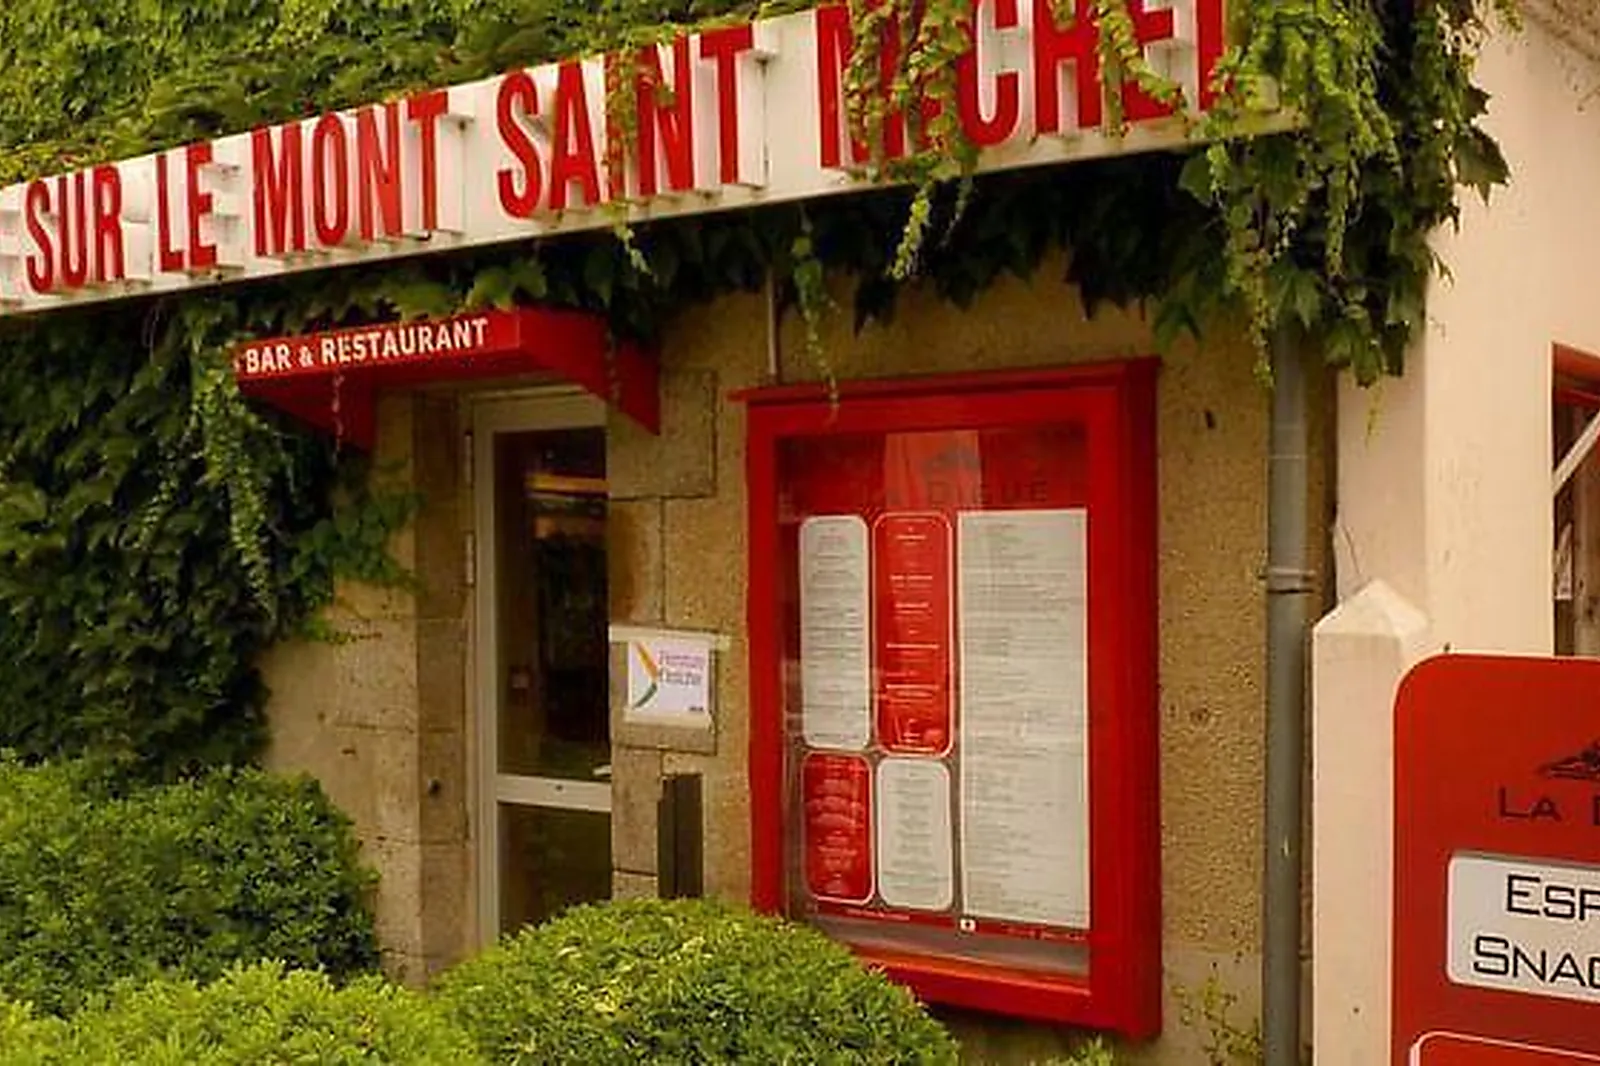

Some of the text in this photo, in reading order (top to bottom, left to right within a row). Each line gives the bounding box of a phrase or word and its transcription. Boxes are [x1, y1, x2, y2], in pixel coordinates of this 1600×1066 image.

[26, 165, 125, 294] SUR
[156, 140, 217, 272] LE
[251, 91, 449, 257] MONT
[497, 24, 753, 220] SAINT
[246, 317, 489, 373] BAR & RESTAURANT
[1499, 787, 1563, 824] LA
